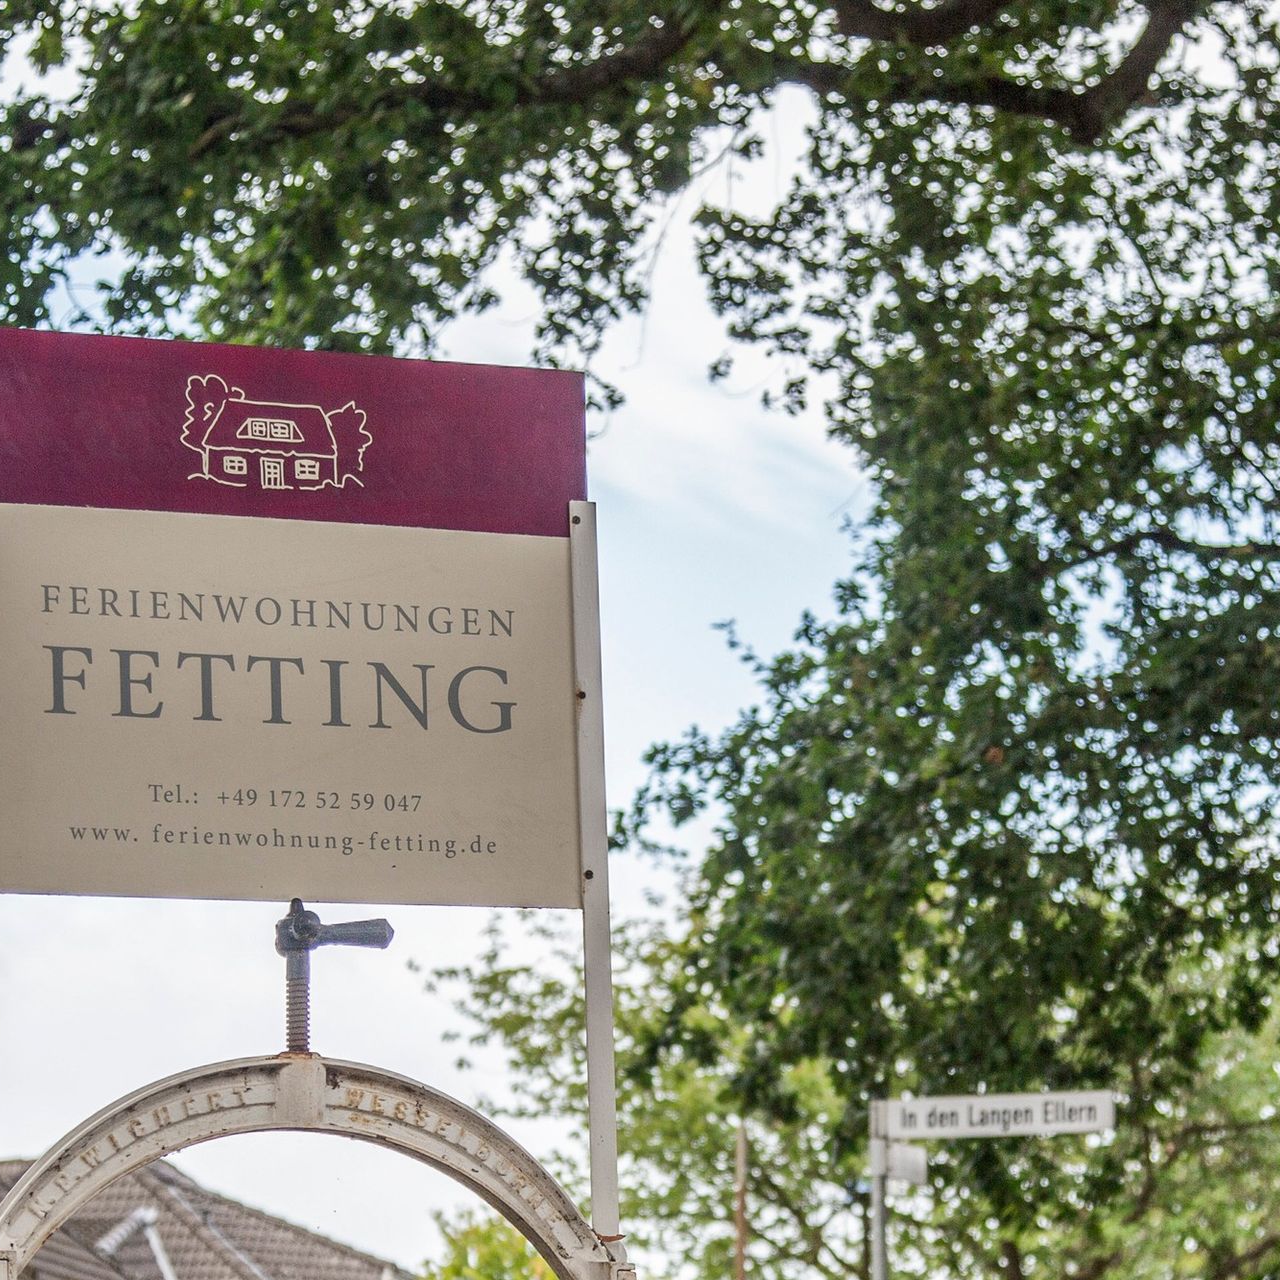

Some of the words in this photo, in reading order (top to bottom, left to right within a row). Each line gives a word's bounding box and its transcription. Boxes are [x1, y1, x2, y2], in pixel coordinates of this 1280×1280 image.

[40, 584, 516, 638] FERIENWOHNUNGEN
[41, 644, 519, 735] FETTING
[147, 783, 199, 805] Tel.:
[216, 788, 258, 807] +49
[269, 789, 307, 809] 172
[315, 791, 342, 810] 52
[350, 792, 376, 811] 59
[383, 793, 422, 813] 047
[152, 823, 498, 859] ferienwohnung-fetting.de
[900, 1107, 918, 1129] In
[926, 1106, 960, 1128] den
[968, 1105, 1034, 1131] Langen
[1042, 1101, 1098, 1124] Ellern
